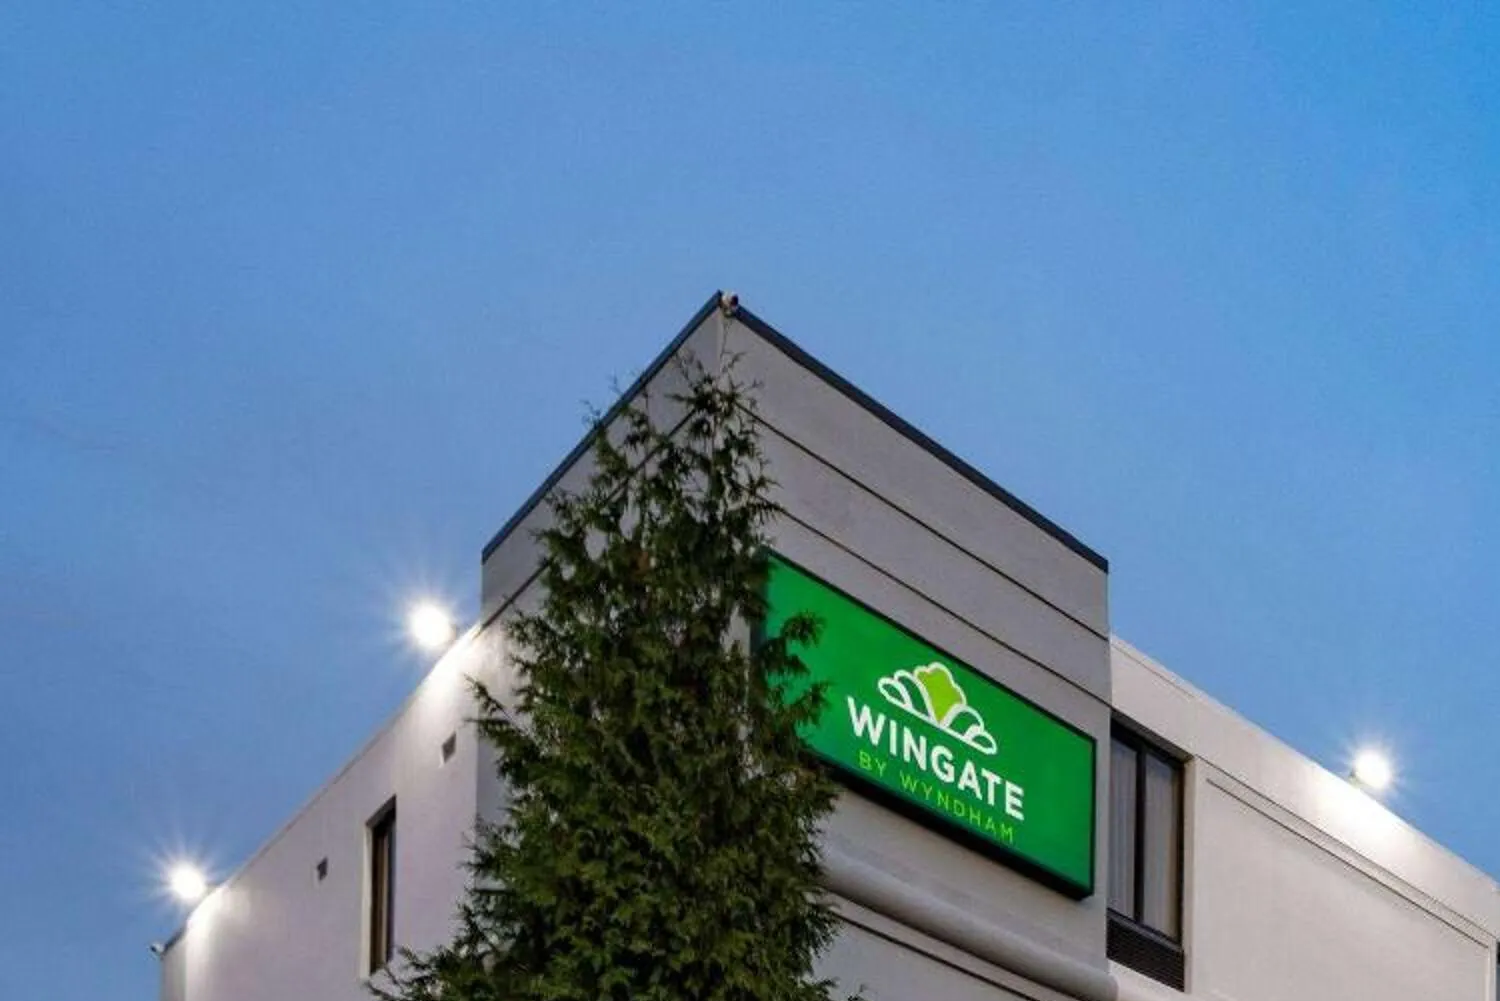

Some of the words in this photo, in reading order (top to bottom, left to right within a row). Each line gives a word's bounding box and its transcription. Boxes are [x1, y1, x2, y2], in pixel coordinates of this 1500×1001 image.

[847, 696, 1024, 820] WINGATE
[858, 751, 886, 776] BY
[900, 771, 1013, 843] WYNDHAM
